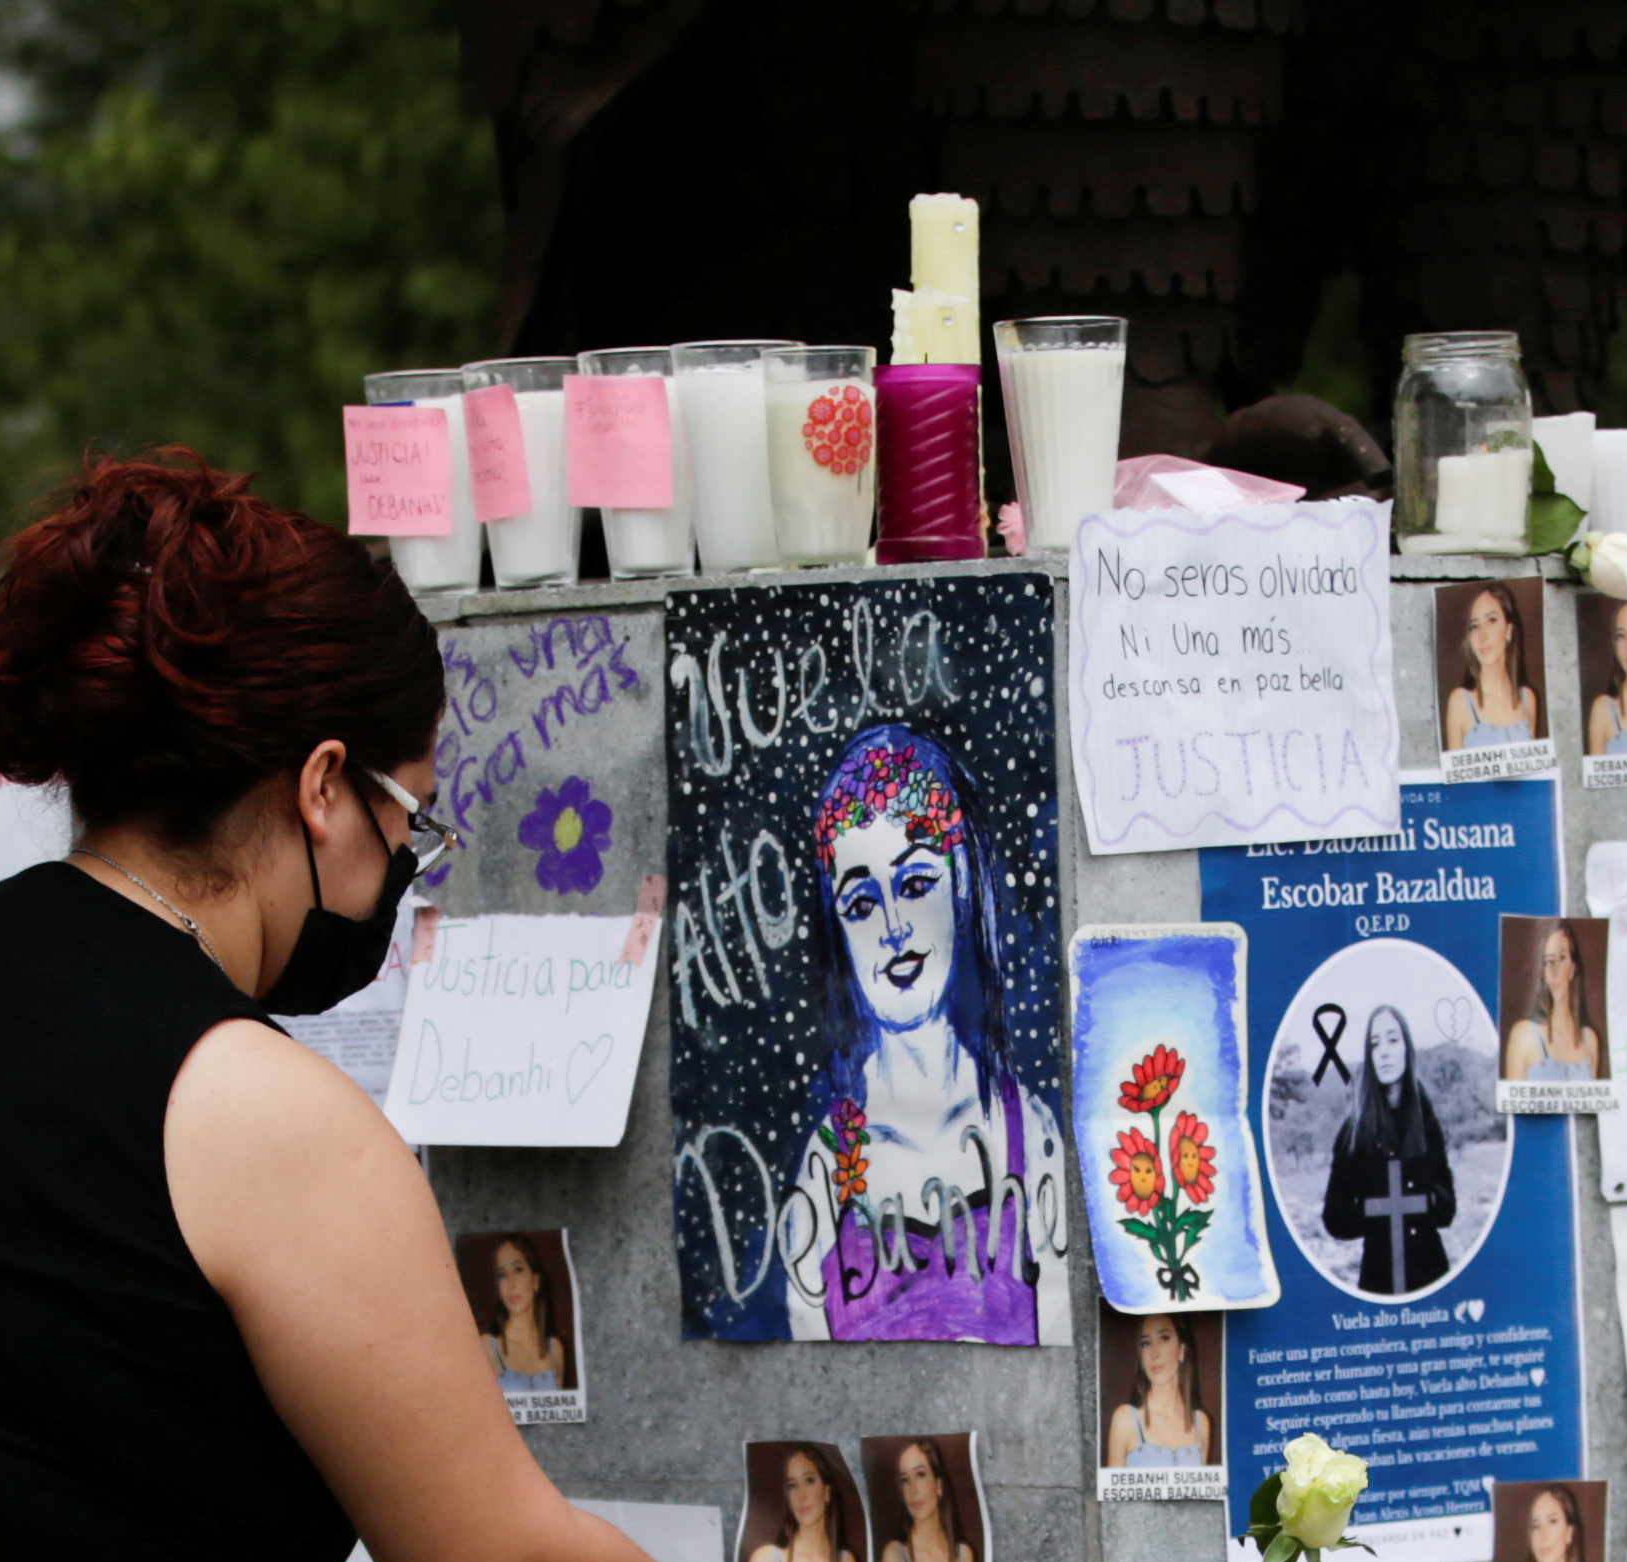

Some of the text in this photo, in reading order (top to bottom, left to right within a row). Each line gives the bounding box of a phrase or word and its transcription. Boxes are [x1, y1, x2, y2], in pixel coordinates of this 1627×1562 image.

[1098, 547, 1146, 600] No
[1260, 553, 1357, 598] olvidada
[1121, 622, 1219, 659] Ni Una
[1103, 664, 1344, 699] descansa en paz bella
[1116, 729, 1371, 801] JUSTICIA
[1445, 757, 1558, 783] ESCOBAR BAZALDUA
[1451, 744, 1549, 768] DEBANHI SUSANA
[1424, 818, 1515, 850] Susana
[1262, 867, 1496, 910] Escobar Bazaldua
[423, 919, 555, 998] Justicia
[565, 957, 632, 1015] para
[409, 1019, 553, 1105] Debanhi
[1567, 1084, 1611, 1098] SUSANA
[1501, 1098, 1620, 1113] ESCOBAR BAZALDUA
[1332, 1307, 1449, 1330] Vuela alto flaquita
[1249, 1348, 1283, 1364] Fuiste
[1286, 1349, 1308, 1361] una
[1311, 1347, 1337, 1363] gran
[1411, 1338, 1436, 1354] gran
[1439, 1332, 1474, 1350] amiga
[1476, 1334, 1484, 1349] y
[1257, 1369, 1312, 1386] excelente
[1315, 1369, 1332, 1381] ser
[1334, 1364, 1384, 1380] humano
[1387, 1363, 1395, 1379] y
[1397, 1362, 1418, 1374] una
[1421, 1360, 1447, 1376] gran
[1488, 1353, 1500, 1366] te
[531, 1396, 577, 1409] SUSANA
[1324, 1390, 1357, 1403] como
[1360, 1385, 1390, 1401] hasta
[1420, 1378, 1453, 1394] Vuela
[1455, 1375, 1477, 1391] alto
[526, 1409, 583, 1422] BAZALDUA
[1266, 1395, 1542, 1434] Seguiré esperando tu llamada para contarme tus
[1331, 1433, 1369, 1451] alguna
[1468, 1417, 1514, 1436] muchos
[1515, 1414, 1554, 1435] planes
[1397, 1449, 1413, 1465] las
[1415, 1445, 1476, 1463] vacaciones
[1479, 1440, 1493, 1457] de
[1103, 1486, 1229, 1500] ESCOBAR BAZALDUA
[1110, 1472, 1222, 1486] DEBANHI SUSANA
[1388, 1488, 1406, 1504] por
[1453, 1478, 1480, 1496] TQM
[1353, 1510, 1376, 1526] Juan
[1380, 1506, 1409, 1521] Alexis
[1412, 1503, 1443, 1518] Acosta
